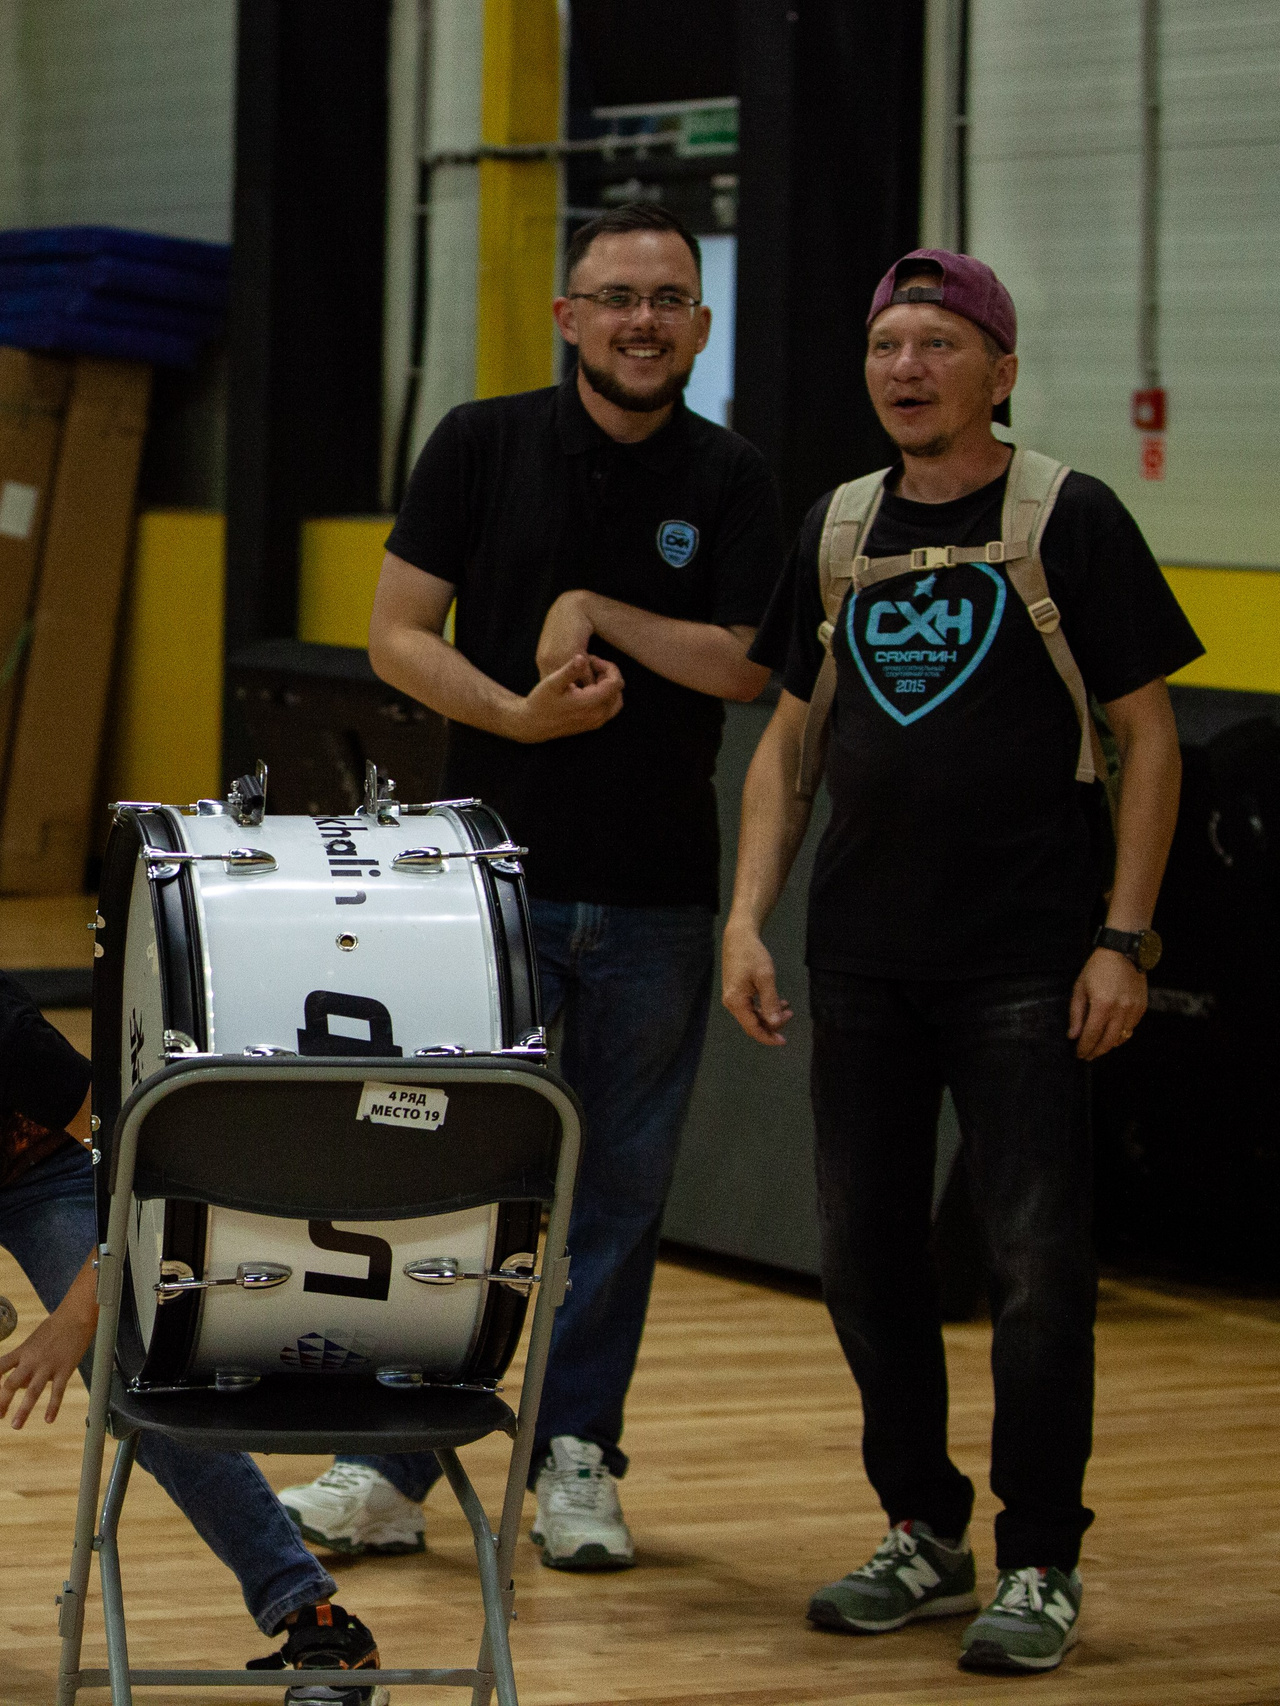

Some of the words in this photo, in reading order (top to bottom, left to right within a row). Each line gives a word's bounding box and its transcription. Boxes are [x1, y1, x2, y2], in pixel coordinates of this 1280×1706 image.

[895, 679, 926, 693] 2015
[310, 815, 381, 905] khalin
[389, 1091, 397, 1101] 4
[400, 1092, 427, 1107] РЯД
[370, 1104, 421, 1120] МЕСТО
[424, 1110, 440, 1121] 19
